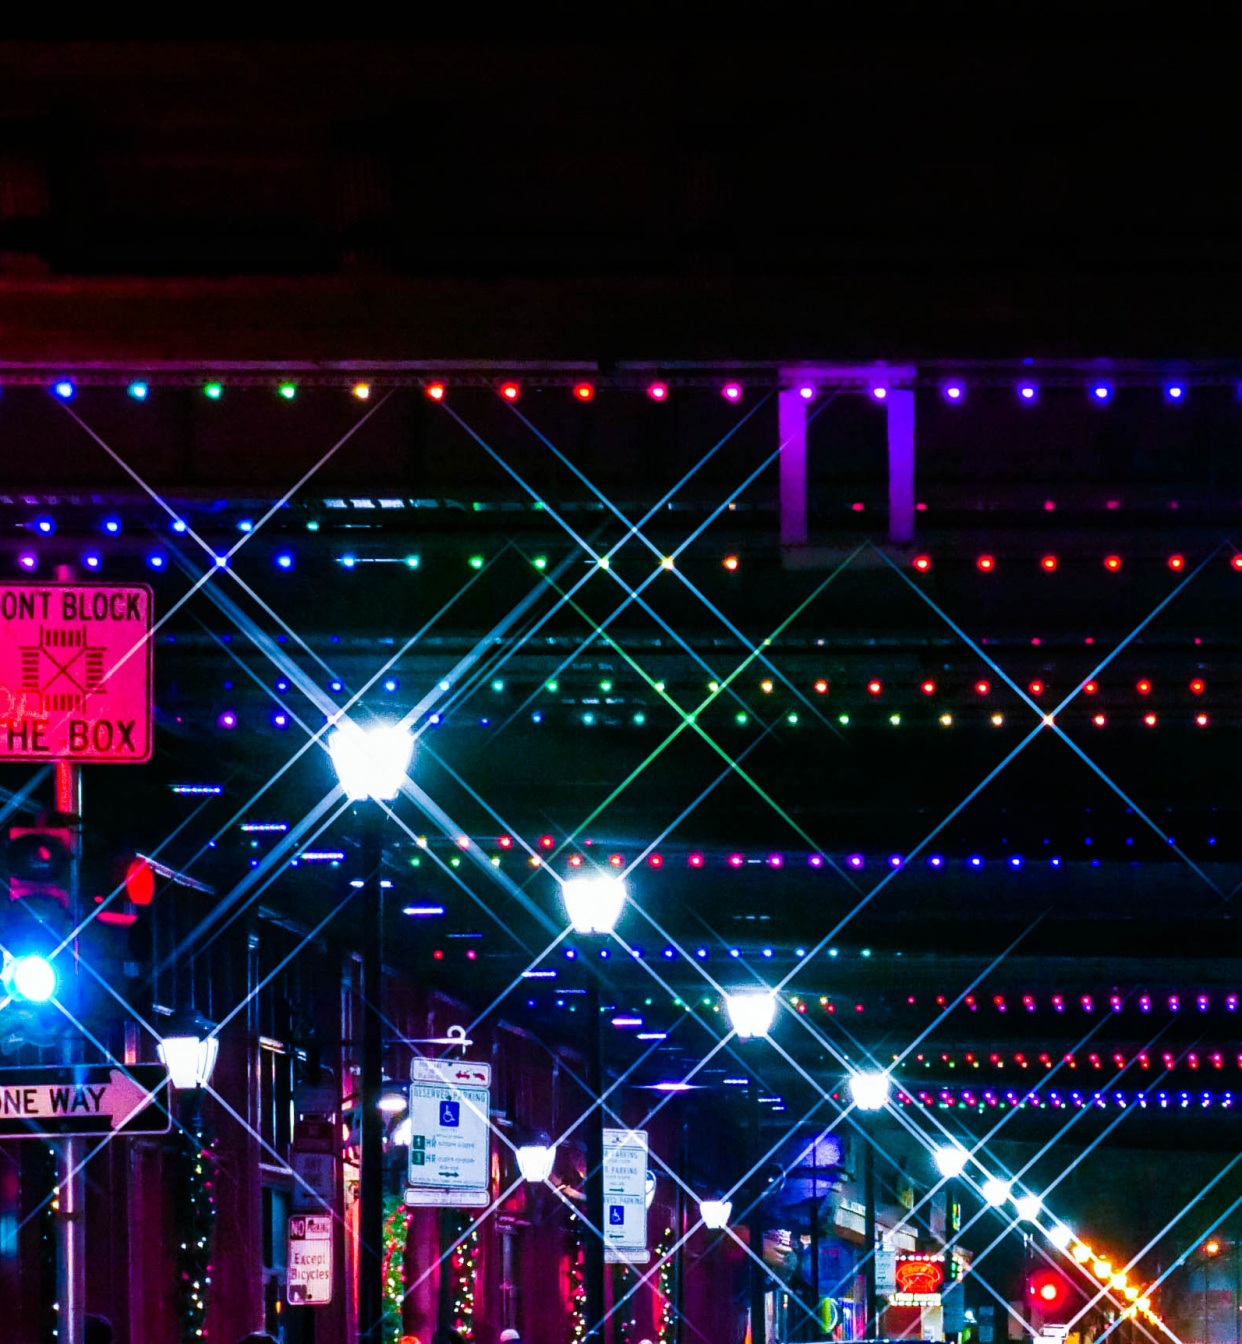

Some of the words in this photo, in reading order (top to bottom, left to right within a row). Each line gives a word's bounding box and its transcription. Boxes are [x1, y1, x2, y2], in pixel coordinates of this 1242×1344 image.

[62, 592, 142, 621] BLOCK
[69, 720, 136, 752] BOX
[0, 1088, 40, 1115] NE
[50, 1086, 106, 1114] WAY
[291, 1220, 305, 1238] NO
[294, 1253, 326, 1266] Except
[290, 1268, 329, 1281] Bicycles
